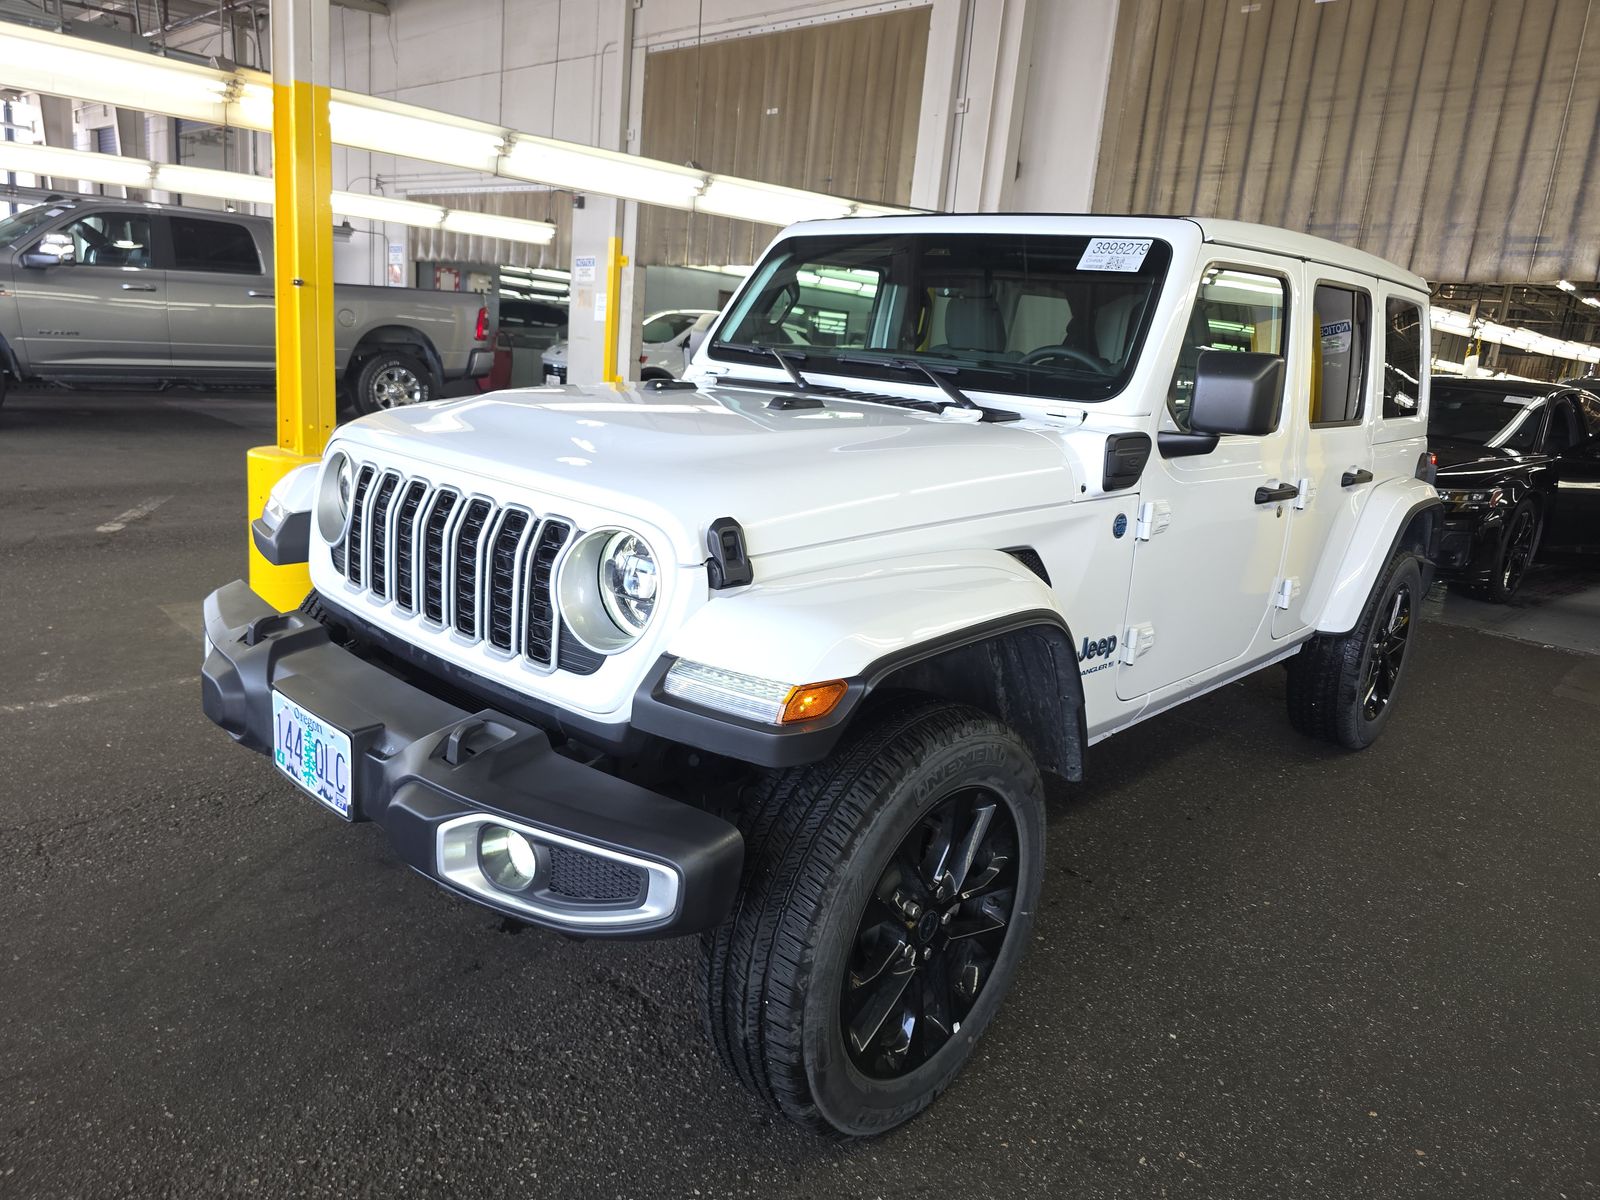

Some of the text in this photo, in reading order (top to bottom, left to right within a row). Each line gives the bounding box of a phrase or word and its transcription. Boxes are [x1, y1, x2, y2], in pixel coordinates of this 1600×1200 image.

[1092, 242, 1149, 255] 3998279
[1077, 635, 1117, 662] Jeep
[293, 707, 323, 735] Oregon
[277, 713, 345, 793] 144 QLC
